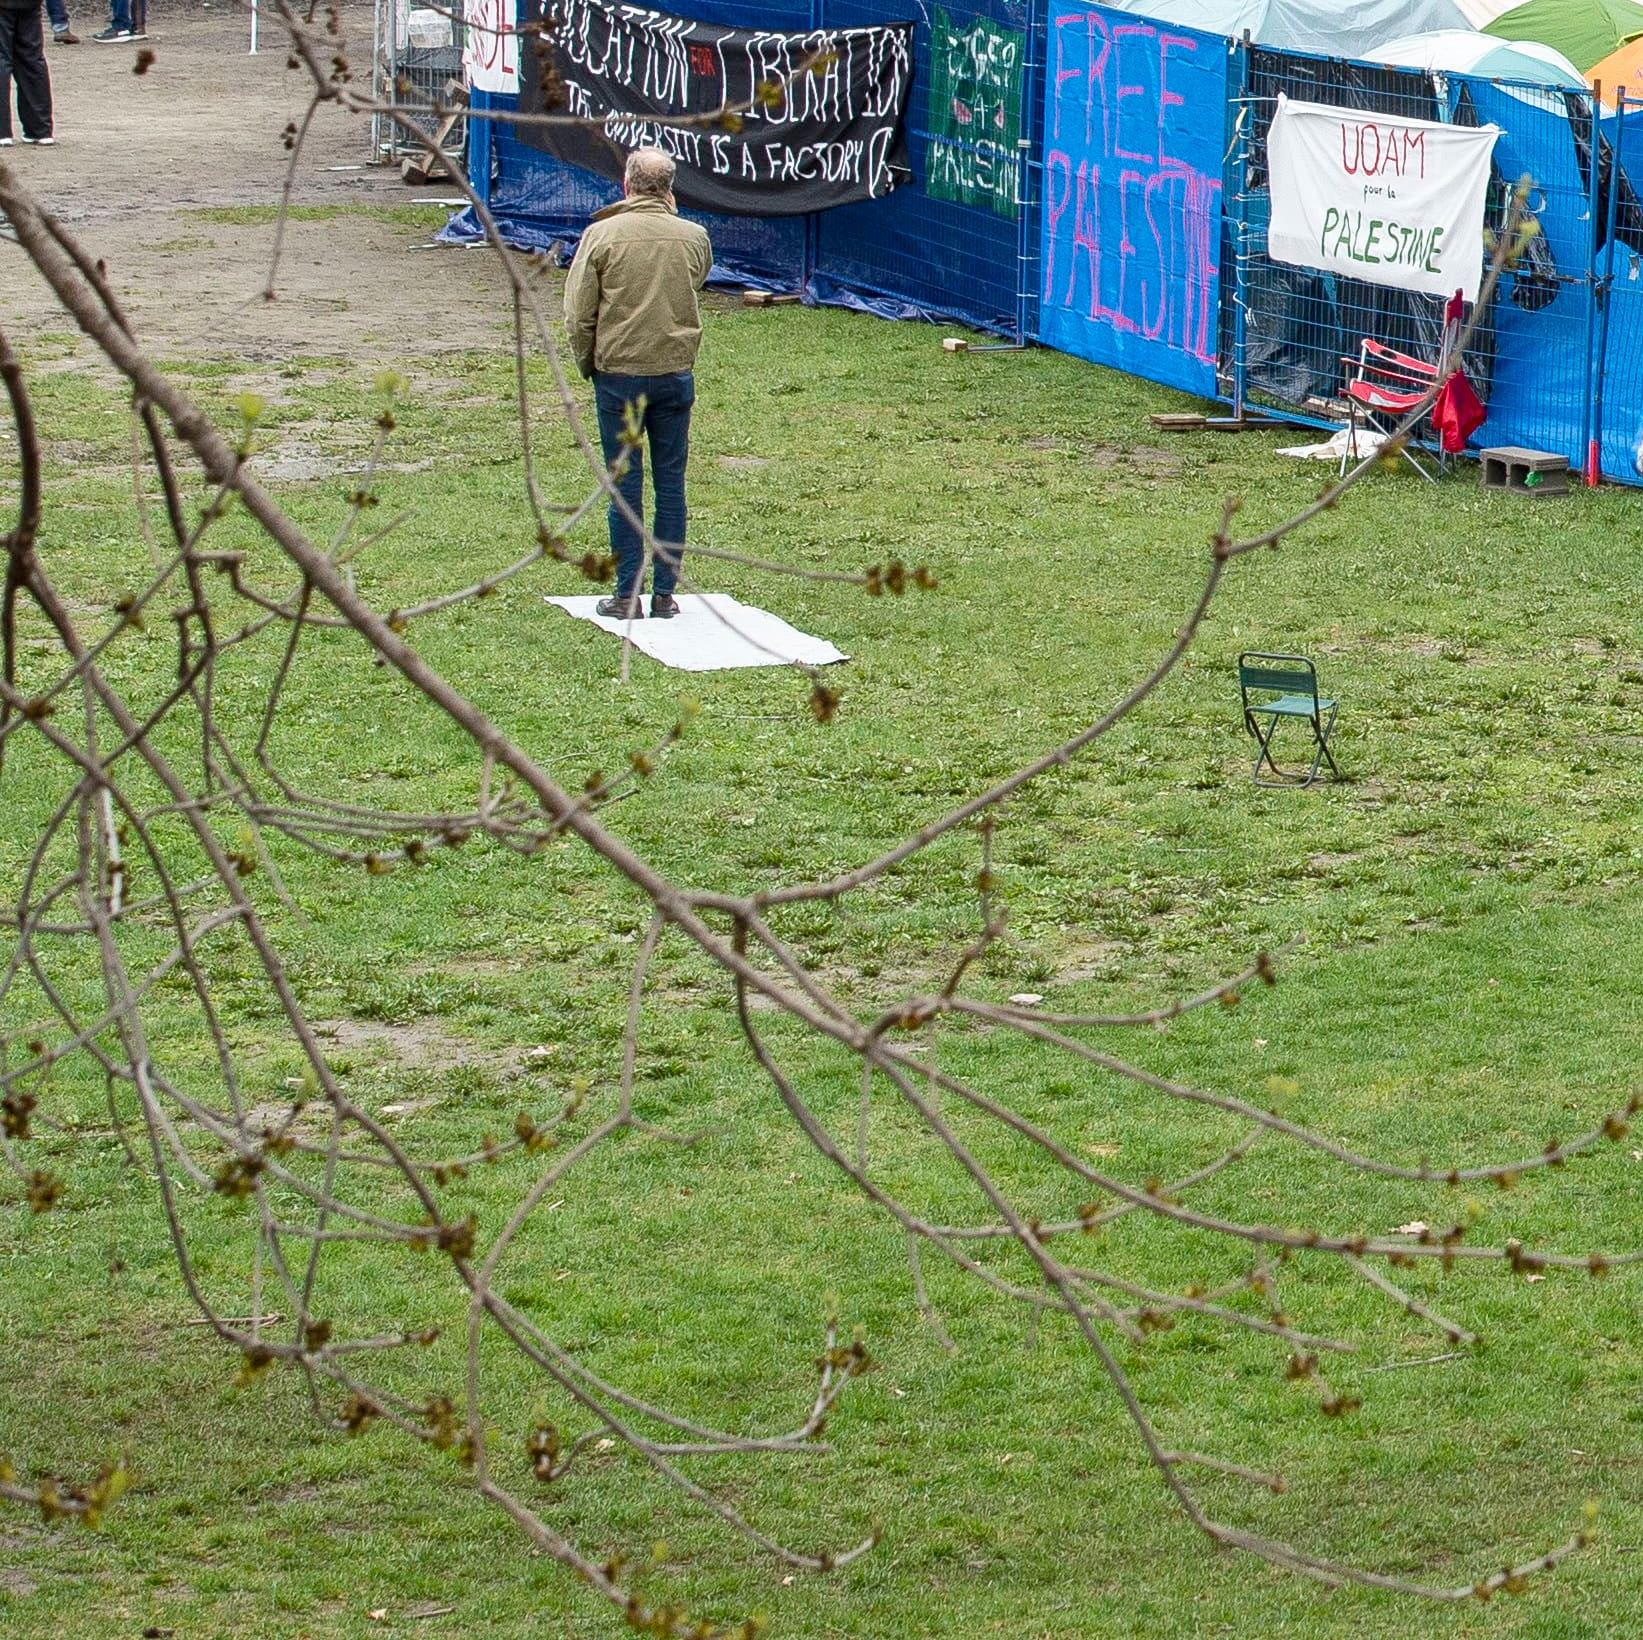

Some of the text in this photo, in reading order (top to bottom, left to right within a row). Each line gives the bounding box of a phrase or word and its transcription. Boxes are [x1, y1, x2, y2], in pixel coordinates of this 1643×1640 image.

[689, 45, 716, 76] FOR
[1055, 11, 1197, 170] FREE
[711, 135, 731, 174] IS
[742, 142, 757, 182] A
[766, 140, 864, 183] FACTORY
[1341, 123, 1426, 180] UQAM
[1363, 183, 1397, 203] pour la
[1044, 149, 1223, 362] PALESTINE
[1321, 207, 1445, 274] PALESTINE
